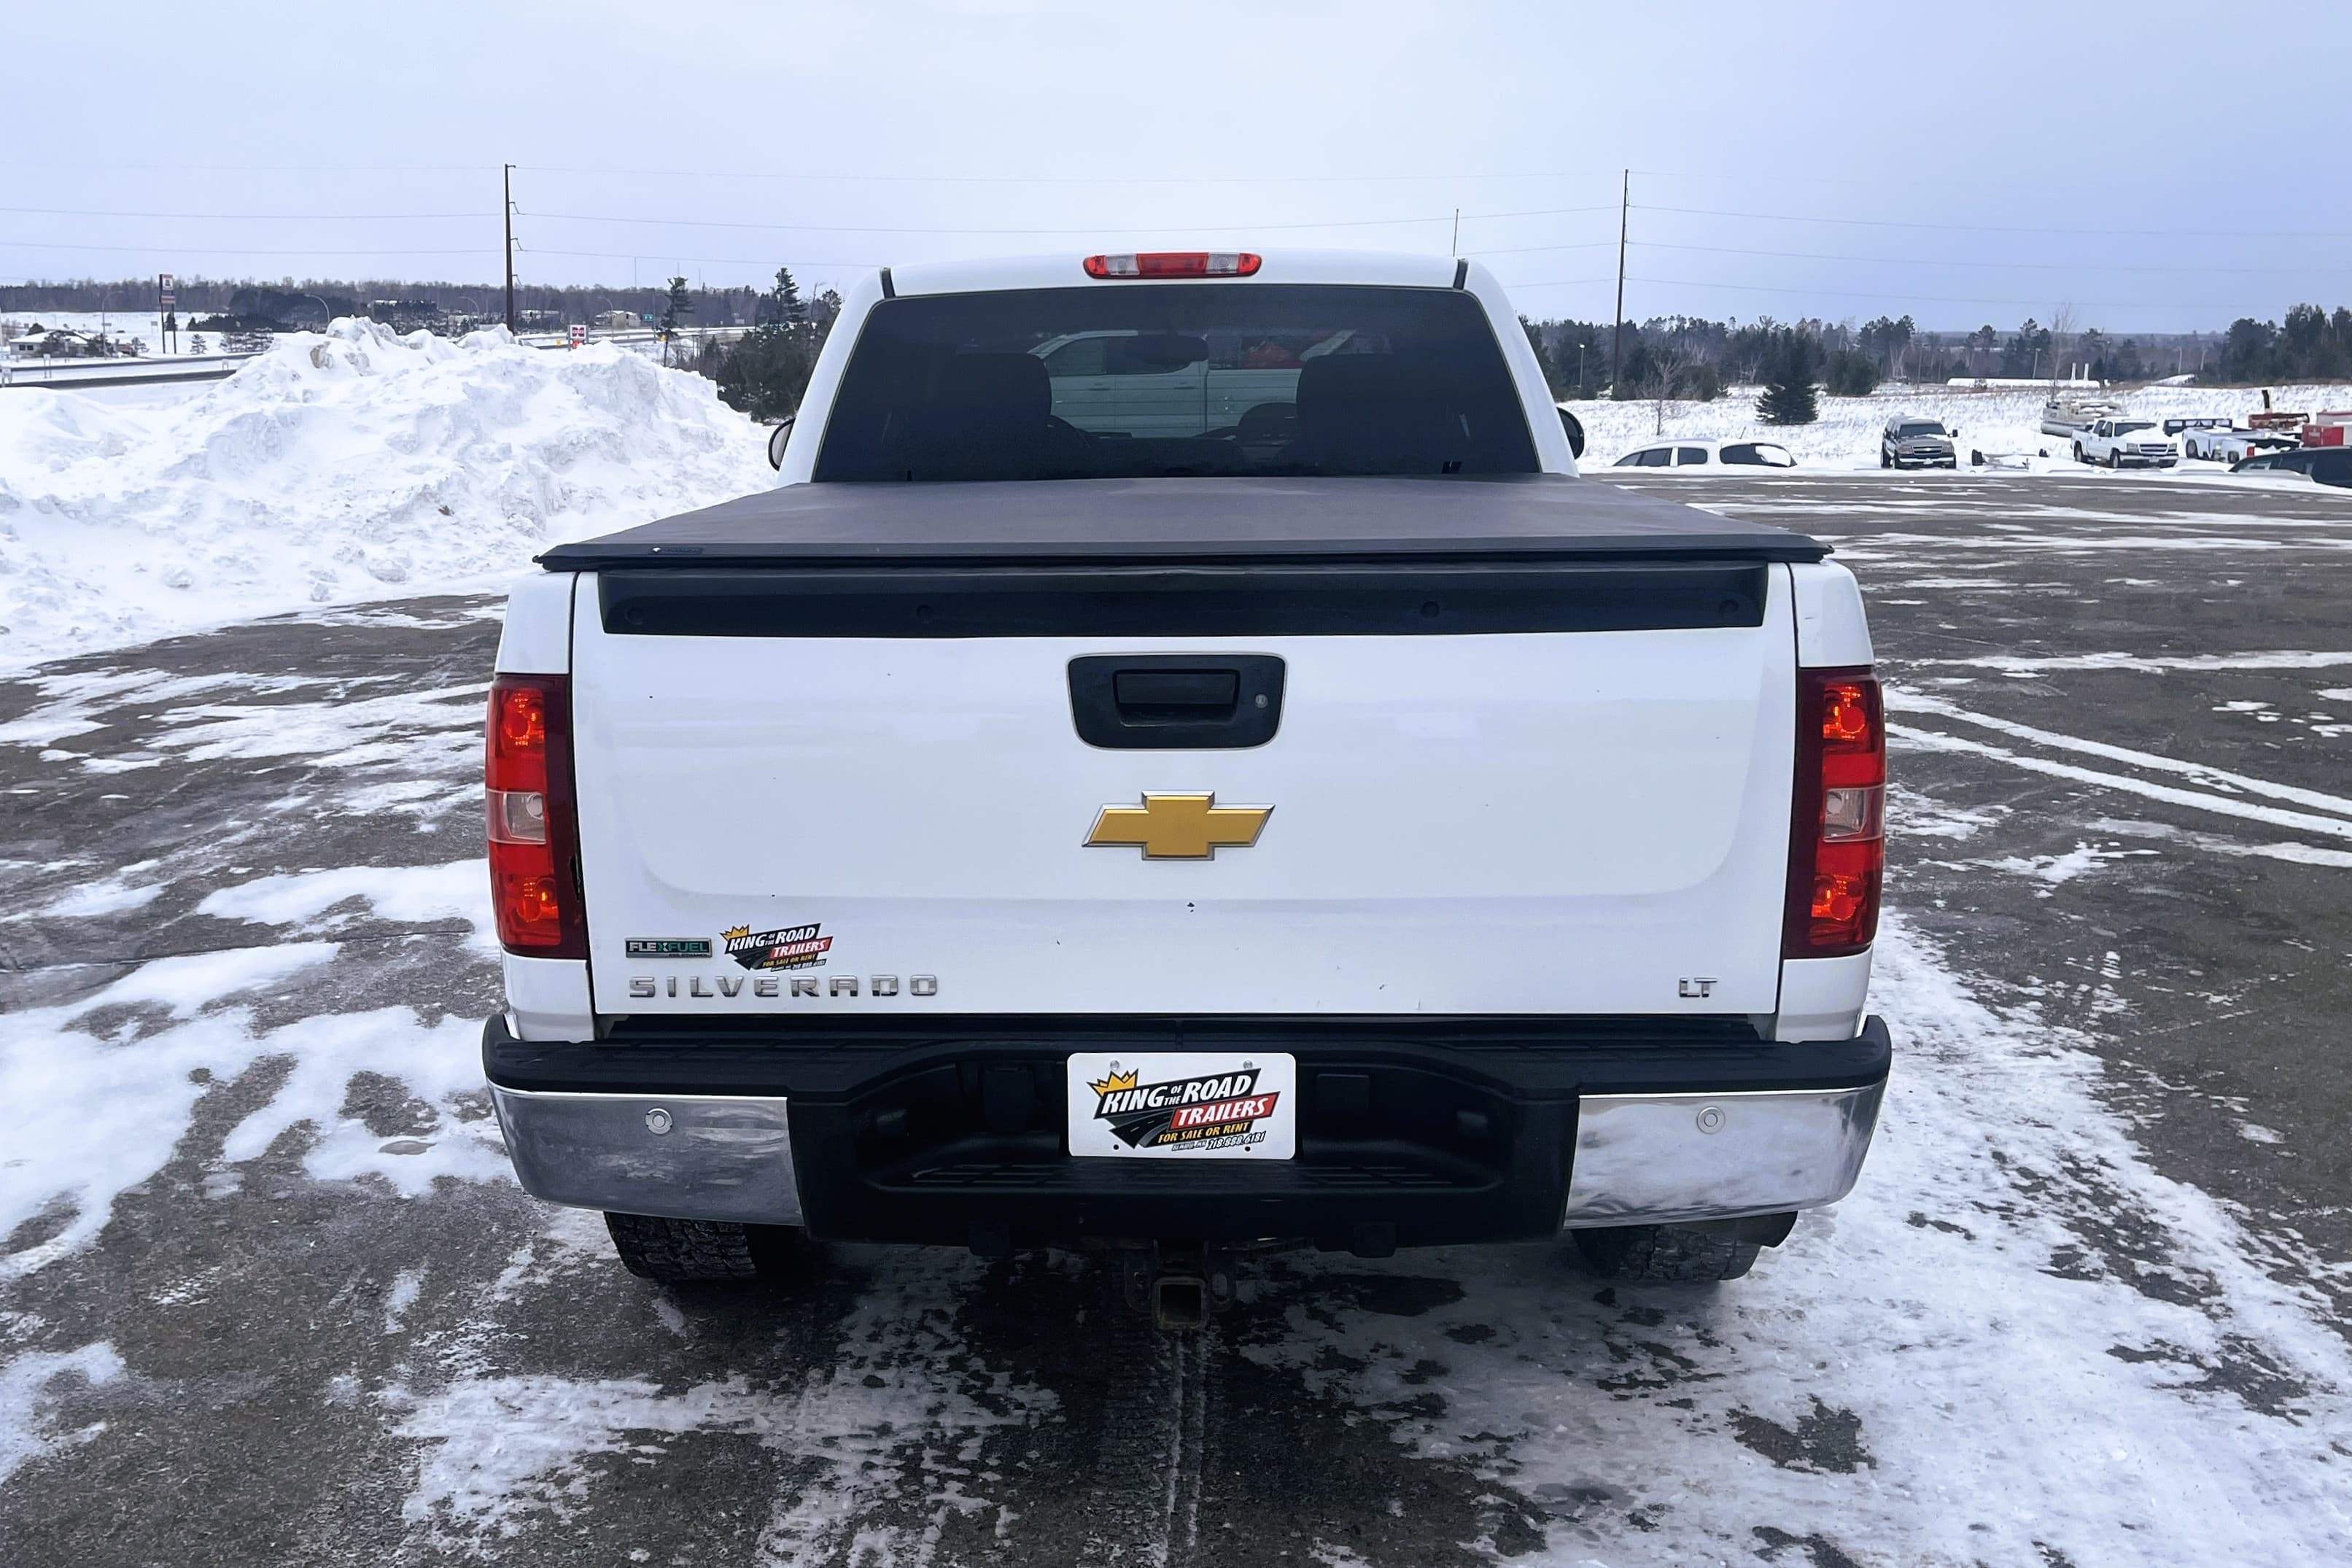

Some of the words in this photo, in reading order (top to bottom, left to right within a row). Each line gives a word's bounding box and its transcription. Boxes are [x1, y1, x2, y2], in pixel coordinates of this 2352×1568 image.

[728, 934, 766, 952] KING
[775, 927, 816, 944] ROAD
[773, 939, 827, 958] TRAILERS
[629, 974, 938, 998] SILVERADO
[1679, 977, 1718, 998] LT
[1101, 1086, 1168, 1114] KING
[1164, 1095, 1181, 1106] THE
[1171, 1084, 1183, 1095] OF
[1181, 1075, 1252, 1103] ROAD
[1177, 1098, 1269, 1127] TRAILERS
[1157, 1132, 1178, 1144] FOR
[1179, 1127, 1203, 1140] SALE
[1205, 1125, 1220, 1136] OR
[1224, 1122, 1249, 1134] RENT
